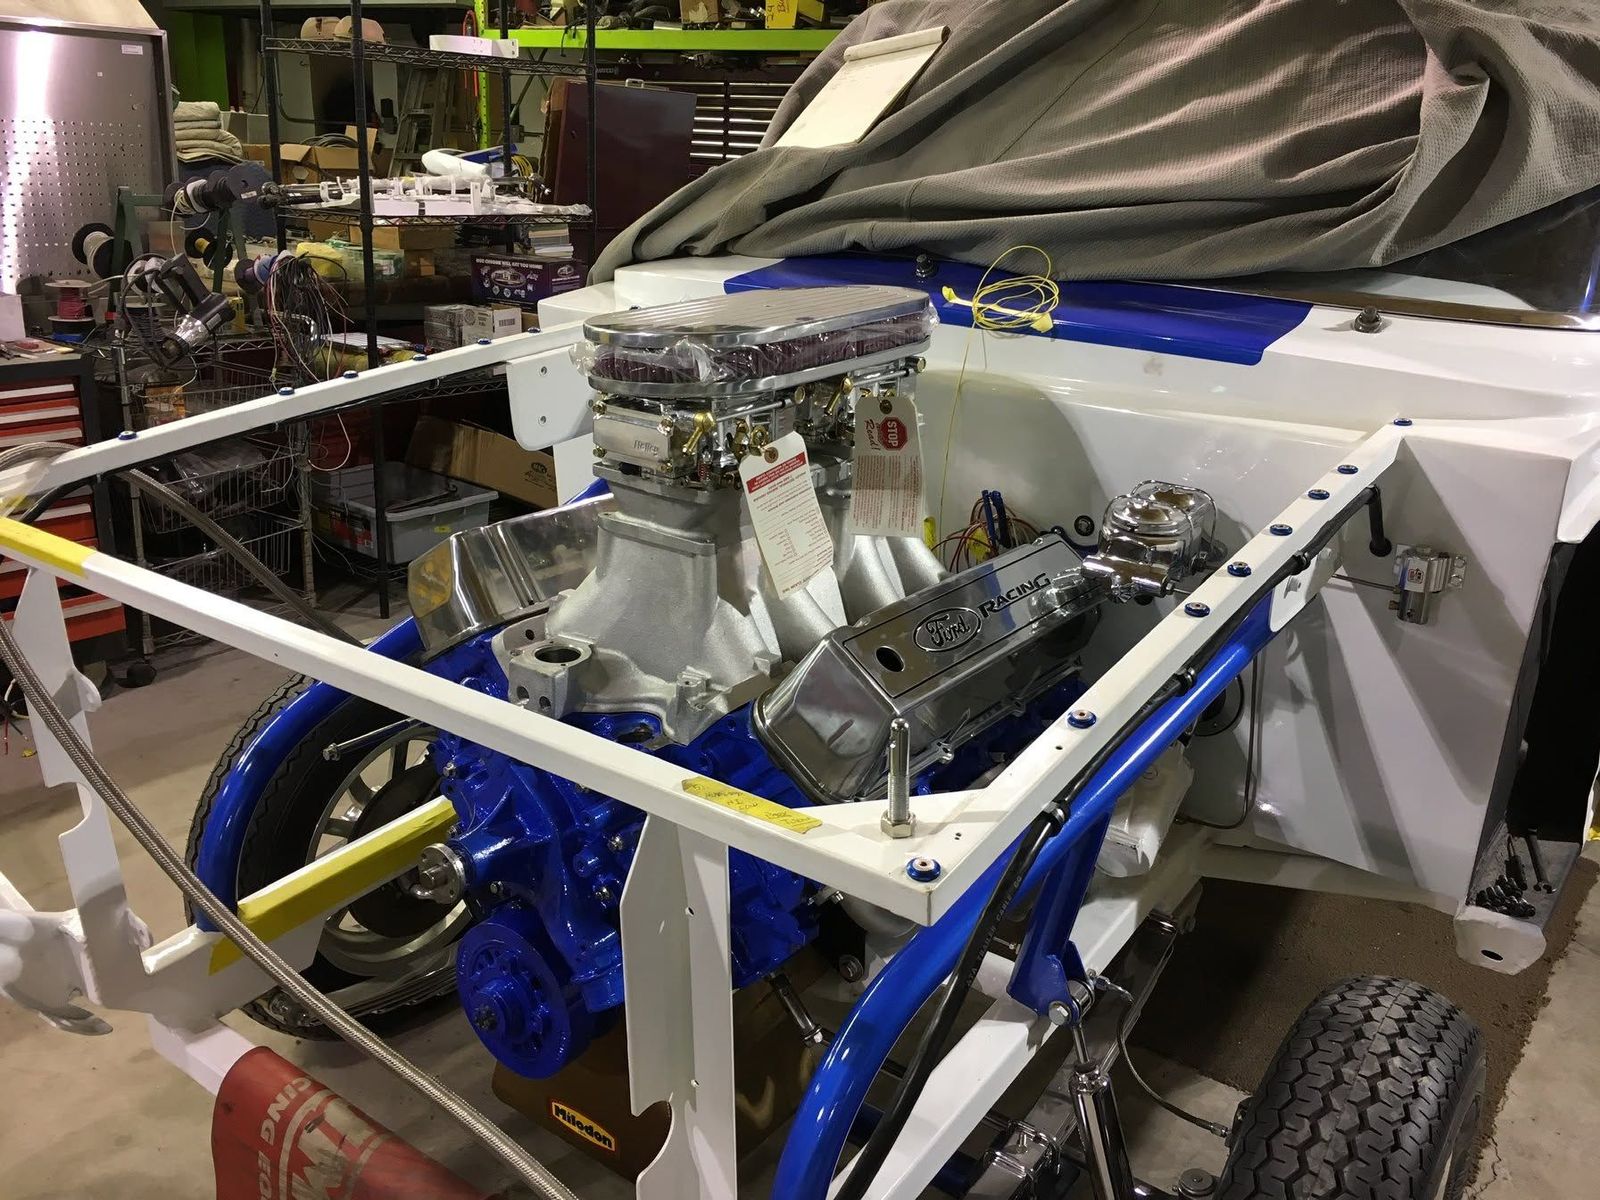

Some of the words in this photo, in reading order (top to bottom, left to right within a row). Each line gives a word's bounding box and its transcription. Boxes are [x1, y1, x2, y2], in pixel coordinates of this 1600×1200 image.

[864, 418, 880, 450] Read!
[887, 421, 899, 447] STOP
[977, 573, 1051, 619] RACING
[926, 613, 971, 647] Ford
[553, 1103, 613, 1149] Milodon
